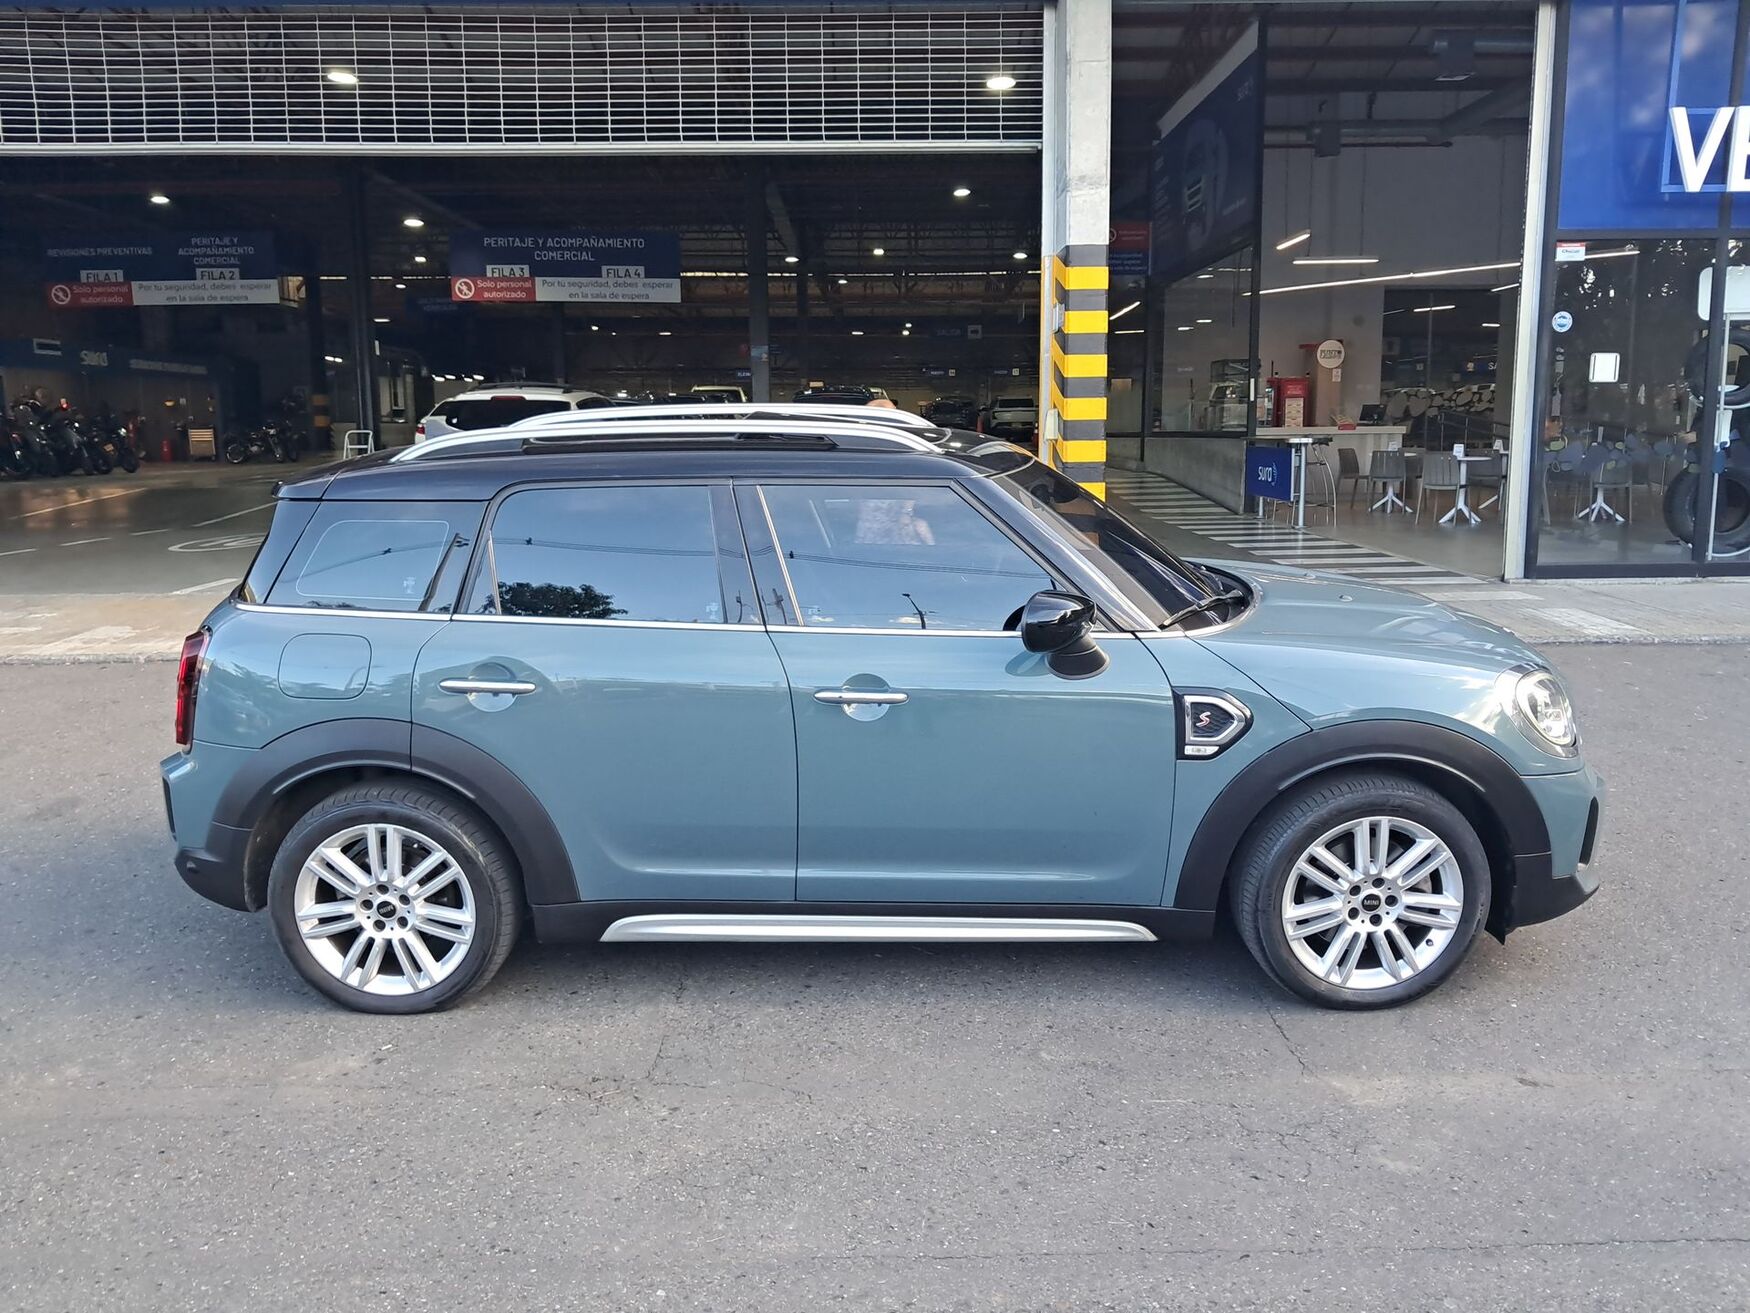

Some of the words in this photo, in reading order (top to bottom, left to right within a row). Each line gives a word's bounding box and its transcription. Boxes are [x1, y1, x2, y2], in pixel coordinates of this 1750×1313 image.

[191, 236, 231, 245] PERITAJE
[232, 236, 239, 245] Y
[483, 236, 536, 248] PERITAJE
[536, 237, 544, 248] Y
[546, 235, 645, 248] ACOMPAÑAMIENTO
[97, 246, 153, 256] PREVENTIVAS
[178, 244, 255, 256] ACOMPAÑAMIENTO
[534, 250, 596, 261] COMERCIAL
[193, 256, 241, 265] COMERCIAL
[86, 272, 113, 282] FILA
[114, 272, 119, 282] 1
[200, 270, 226, 280] FILA
[228, 270, 235, 280] 2
[491, 267, 517, 277] FILA
[518, 267, 525, 277] 3
[606, 268, 631, 278] FILA
[633, 268, 641, 278] 4
[72, 284, 92, 293] Solo
[93, 284, 129, 296] personal
[138, 282, 154, 291] Por
[154, 283, 163, 291] tu
[210, 282, 237, 290] debes
[239, 283, 272, 293] esperar
[476, 279, 496, 288] Solo
[496, 279, 533, 291] personal
[541, 279, 556, 288] Por
[557, 280, 567, 288] tu
[612, 280, 638, 289] debes
[641, 281, 673, 291] esperar
[483, 290, 527, 299] autorizado
[580, 291, 589, 299] la
[590, 291, 607, 299] sala
[608, 291, 620, 299] de
[621, 292, 650, 302] espera
[1195, 711, 1211, 728] S
